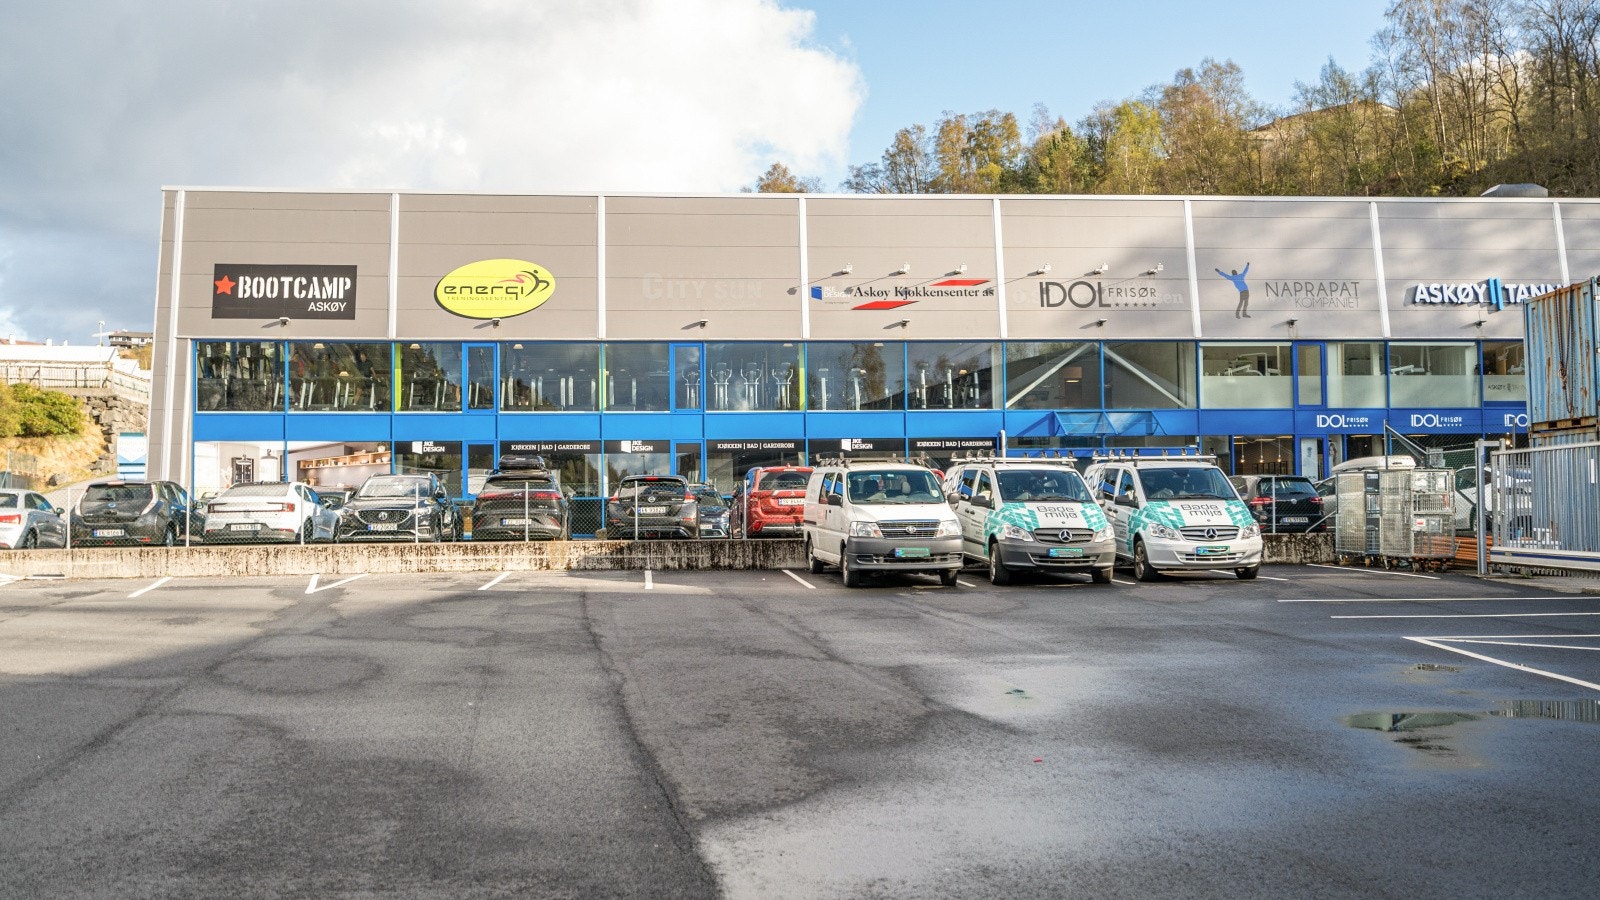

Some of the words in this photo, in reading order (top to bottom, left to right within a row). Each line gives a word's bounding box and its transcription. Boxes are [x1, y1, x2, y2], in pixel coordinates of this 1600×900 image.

[237, 275, 351, 300] BOOTCAMP
[853, 286, 891, 300] Askøy
[894, 286, 980, 300] Kjøkkensenter
[982, 289, 995, 298] as
[1039, 280, 1112, 309] IDOL
[1108, 287, 1157, 299] FRISØR
[1265, 281, 1360, 298] NAPRAPAT
[1414, 282, 1487, 304] ASKØY
[307, 301, 347, 312] ASKØY
[1294, 296, 1360, 309] KOMPANIET
[1316, 414, 1347, 428] IDOL
[1410, 413, 1442, 428] IDOL
[717, 442, 742, 450] KJØKKEN
[746, 442, 758, 450] BAD
[762, 442, 794, 450] GARDEROBE
[916, 440, 942, 448] KJØKKEN
[946, 440, 958, 448] BAD
[962, 440, 993, 448] GARDEROBE
[1036, 505, 1074, 513] Bade
[1180, 503, 1220, 511] Bade
